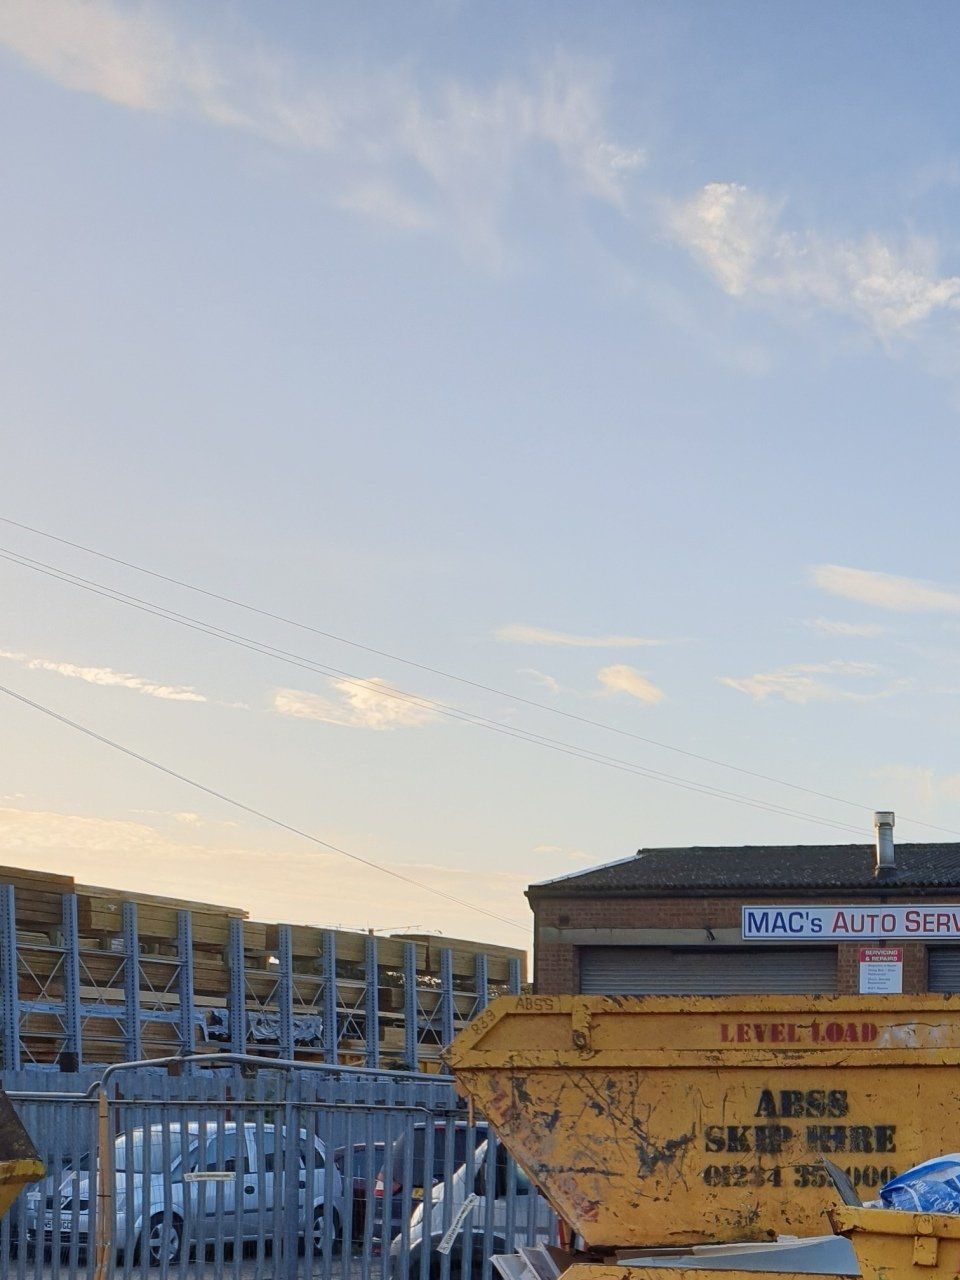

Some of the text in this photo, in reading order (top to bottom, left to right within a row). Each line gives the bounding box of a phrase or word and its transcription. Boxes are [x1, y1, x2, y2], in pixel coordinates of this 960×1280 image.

[747, 911, 823, 934] MAC's
[831, 911, 897, 933] AUTO
[719, 1021, 879, 1043] LEVEL LOAD
[753, 1087, 849, 1119] ABSS
[704, 1124, 897, 1154] SKIP HIRE
[702, 1164, 782, 1188] 01234
